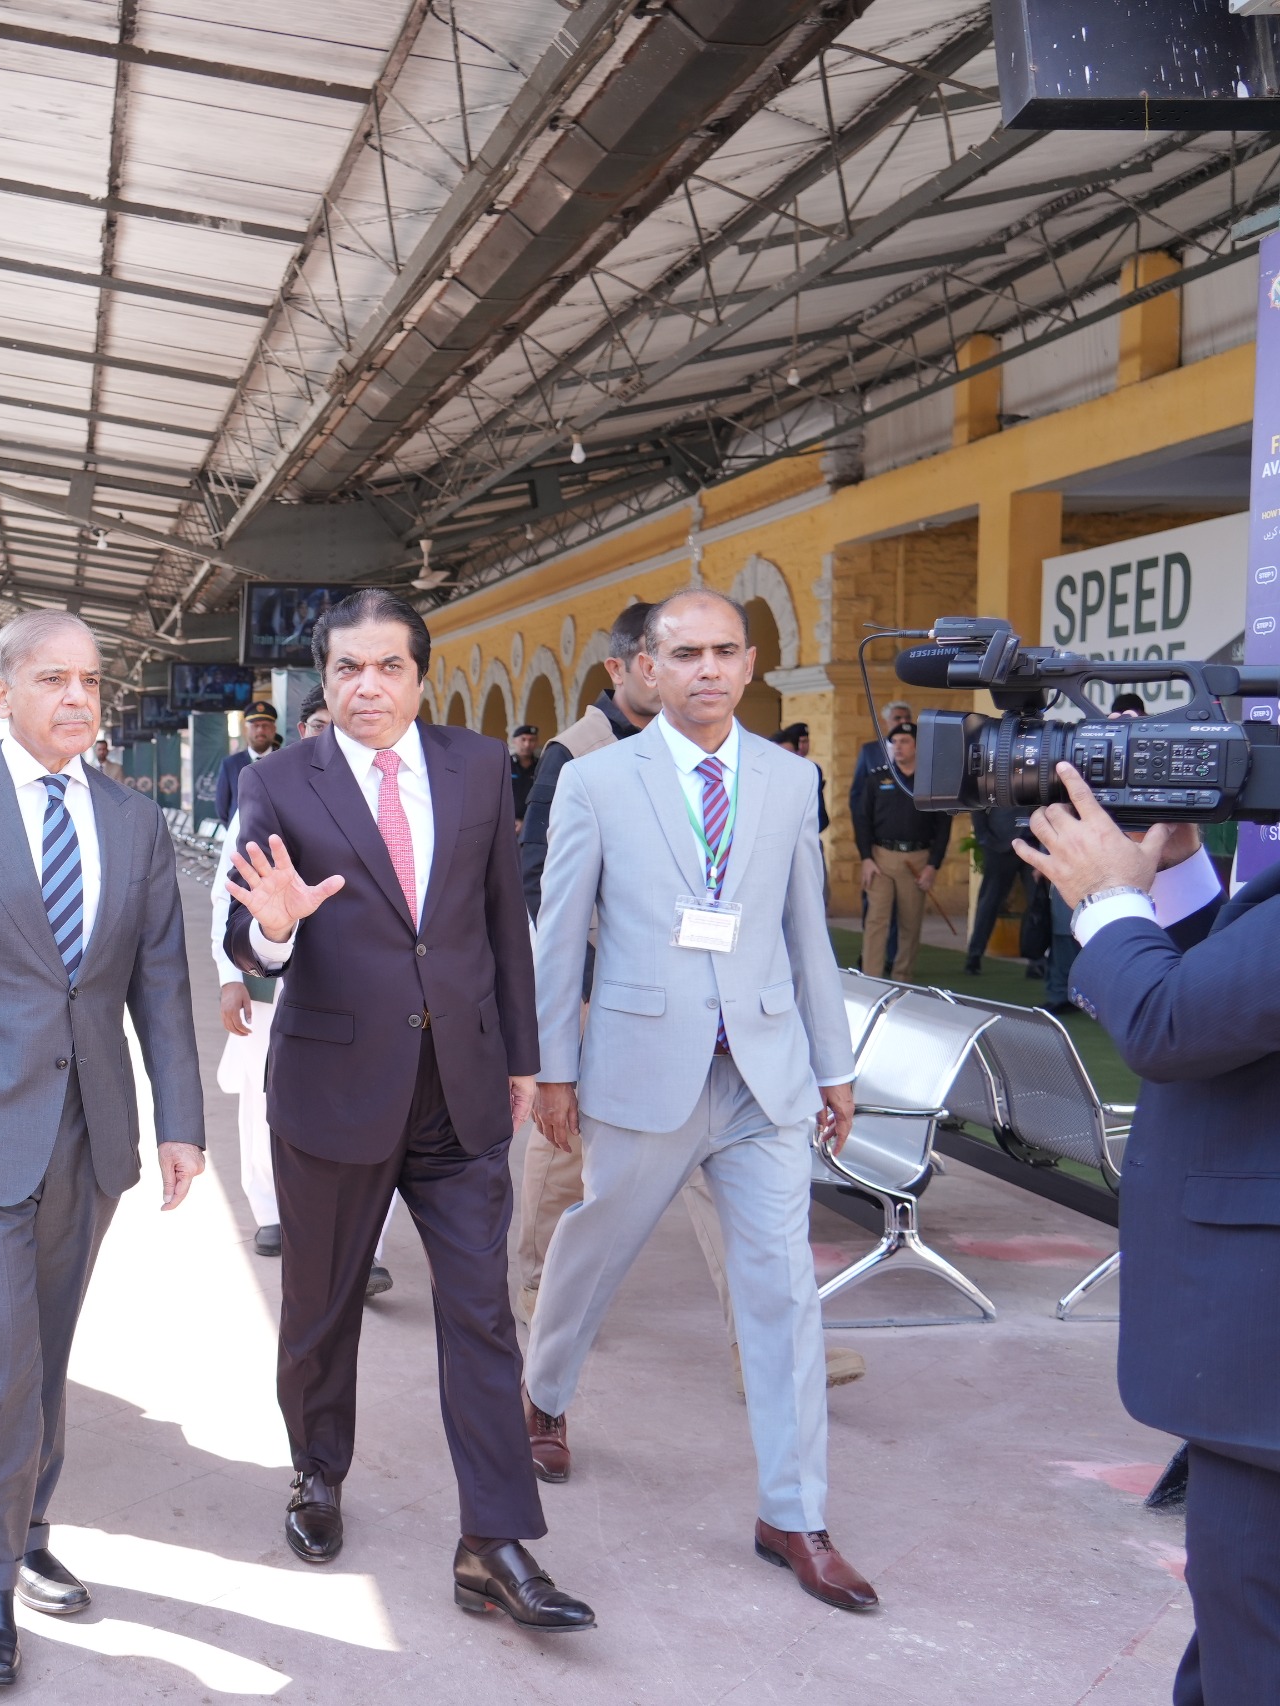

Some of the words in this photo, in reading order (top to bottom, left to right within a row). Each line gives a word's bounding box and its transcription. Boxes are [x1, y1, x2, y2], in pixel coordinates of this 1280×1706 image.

[1271, 434, 1280, 455] F
[1262, 459, 1280, 478] AV
[1258, 571, 1271, 579] STEP
[1053, 552, 1192, 646] SPEED
[1256, 622, 1269, 630] STEP
[1047, 641, 1185, 708] RVICE
[1253, 710, 1266, 718] STEP
[1190, 725, 1232, 733] SONY
